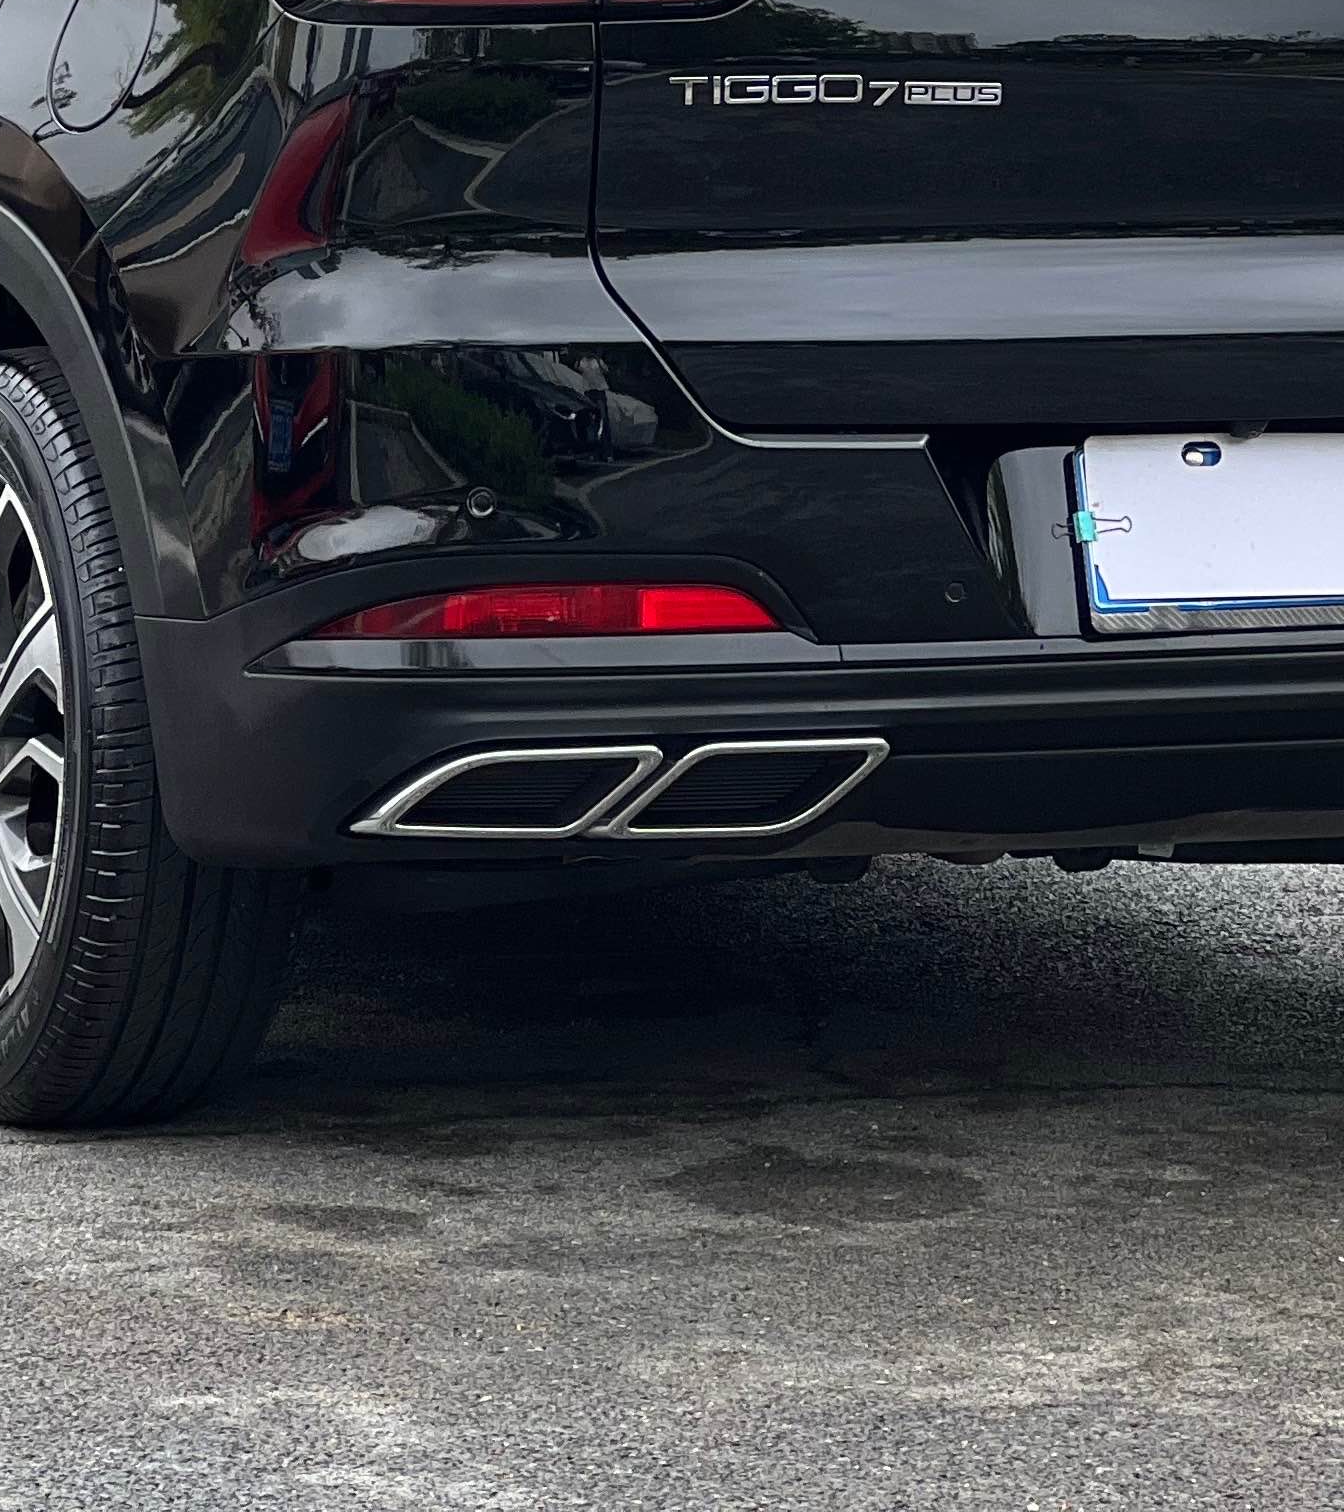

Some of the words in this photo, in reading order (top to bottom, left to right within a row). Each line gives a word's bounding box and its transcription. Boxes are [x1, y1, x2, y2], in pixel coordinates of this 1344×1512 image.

[669, 74, 863, 106] TIGGO
[869, 81, 900, 107] 7
[906, 84, 1001, 105] PLUS
